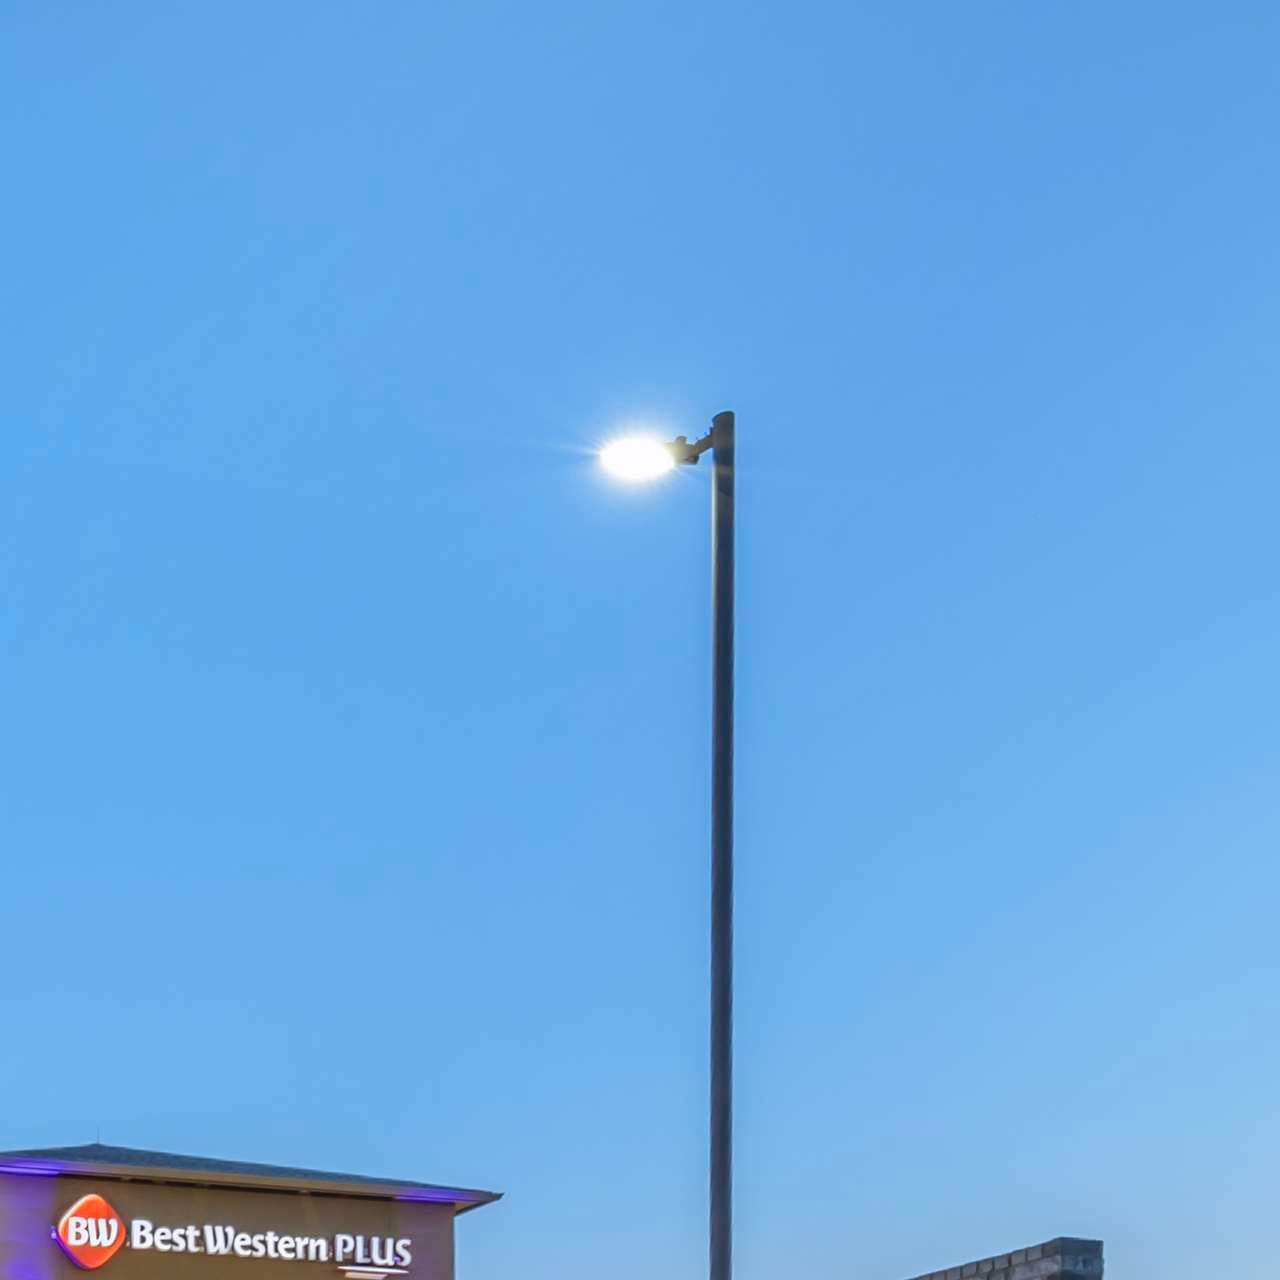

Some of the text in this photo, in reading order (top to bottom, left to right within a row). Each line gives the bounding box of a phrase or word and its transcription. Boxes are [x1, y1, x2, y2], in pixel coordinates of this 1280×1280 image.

[67, 1217, 412, 1267] BW Best Western PLUS
